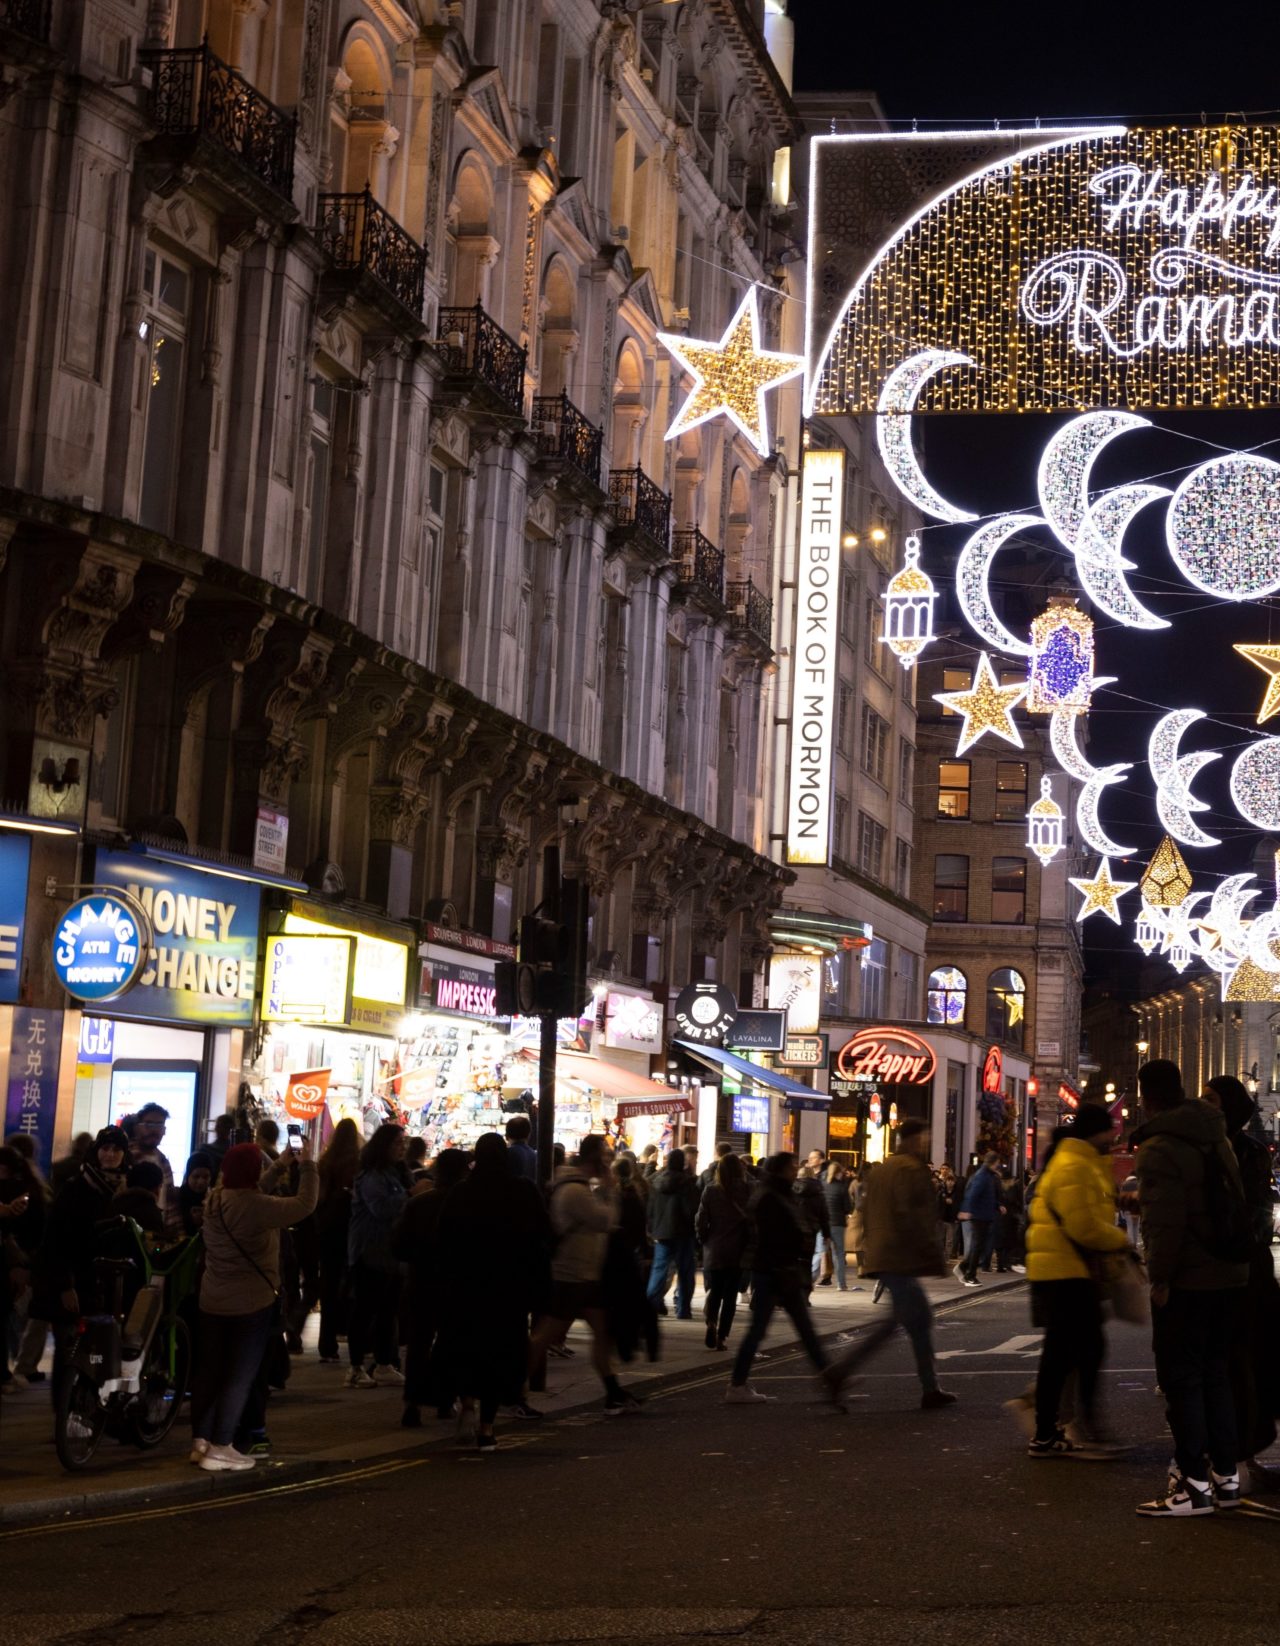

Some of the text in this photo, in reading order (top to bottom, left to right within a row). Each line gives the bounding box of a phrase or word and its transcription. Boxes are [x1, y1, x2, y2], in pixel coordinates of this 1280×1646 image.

[796, 475, 833, 840] THE BOOK OF MORMON
[127, 883, 237, 943] MONEY
[56, 902, 137, 967] CHANGE
[432, 926, 462, 944] SOUVENIRS
[465, 936, 487, 951] LONDON
[81, 940, 111, 955] ATM
[66, 967, 126, 983] MONEY
[140, 946, 255, 1000] CHANGE
[268, 942, 284, 1014] OPEN
[459, 969, 479, 983] LONDON
[676, 1013, 703, 1038] OPEN
[704, 1026, 719, 1039] 24
[723, 1013, 734, 1022] 7
[733, 1034, 773, 1043] LAYALINA
[786, 1051, 817, 1061] TICKETS
[851, 1041, 927, 1083] Happy
[290, 1101, 317, 1113] WALL'S
[624, 1106, 642, 1116] GIFTS
[651, 1103, 685, 1114] SOUVENIRS
